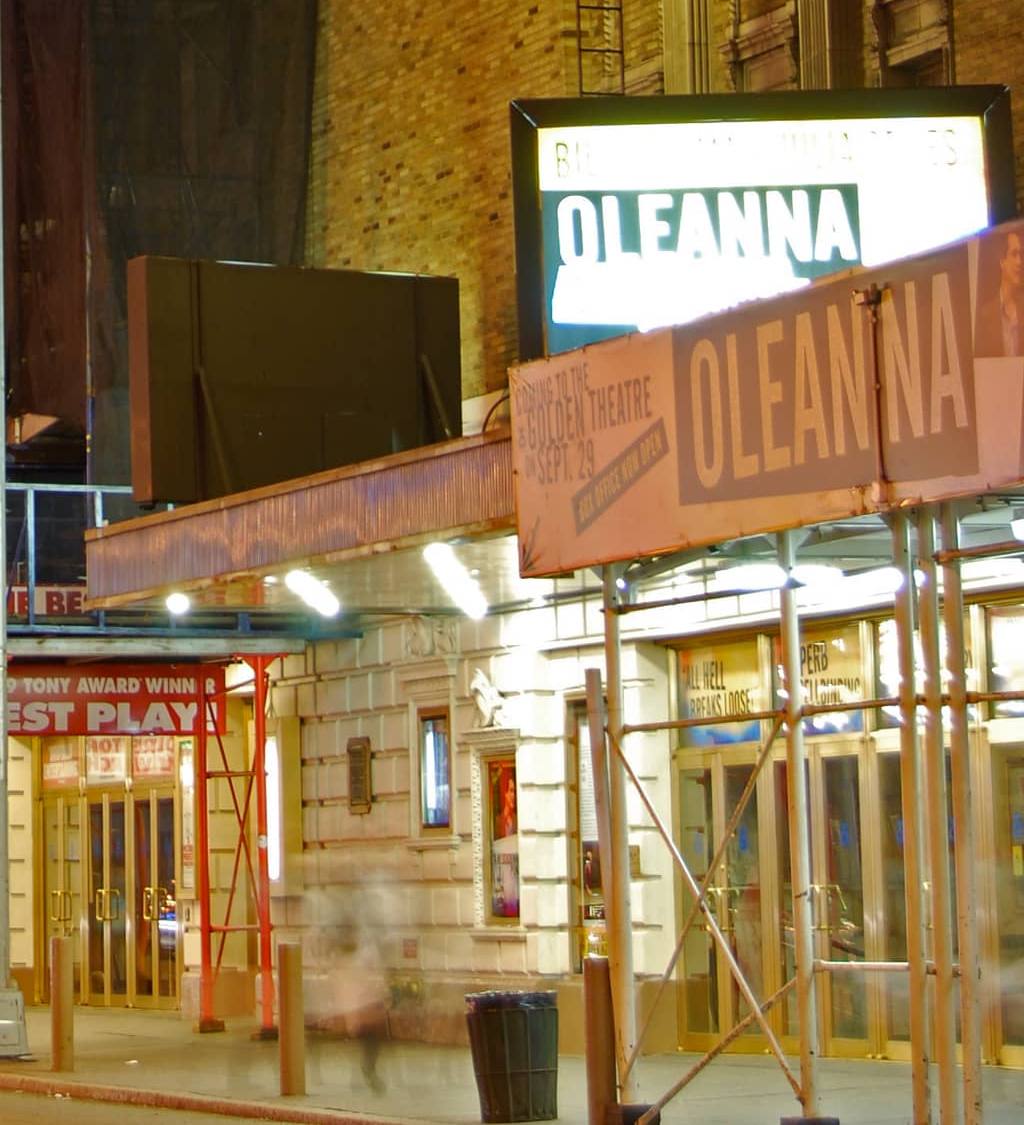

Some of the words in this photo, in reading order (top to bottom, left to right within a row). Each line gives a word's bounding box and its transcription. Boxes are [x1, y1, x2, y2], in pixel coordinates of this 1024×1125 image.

[557, 187, 859, 266] OLEANNA
[689, 271, 969, 490] OLEANNA
[527, 393, 585, 450] GOLDEN
[588, 375, 653, 433] THEATRE
[577, 437, 594, 480] 29
[703, 660, 726, 691] HELL
[800, 640, 829, 676] PERB
[24, 676, 71, 694] TONY
[143, 677, 216, 695] WINNR
